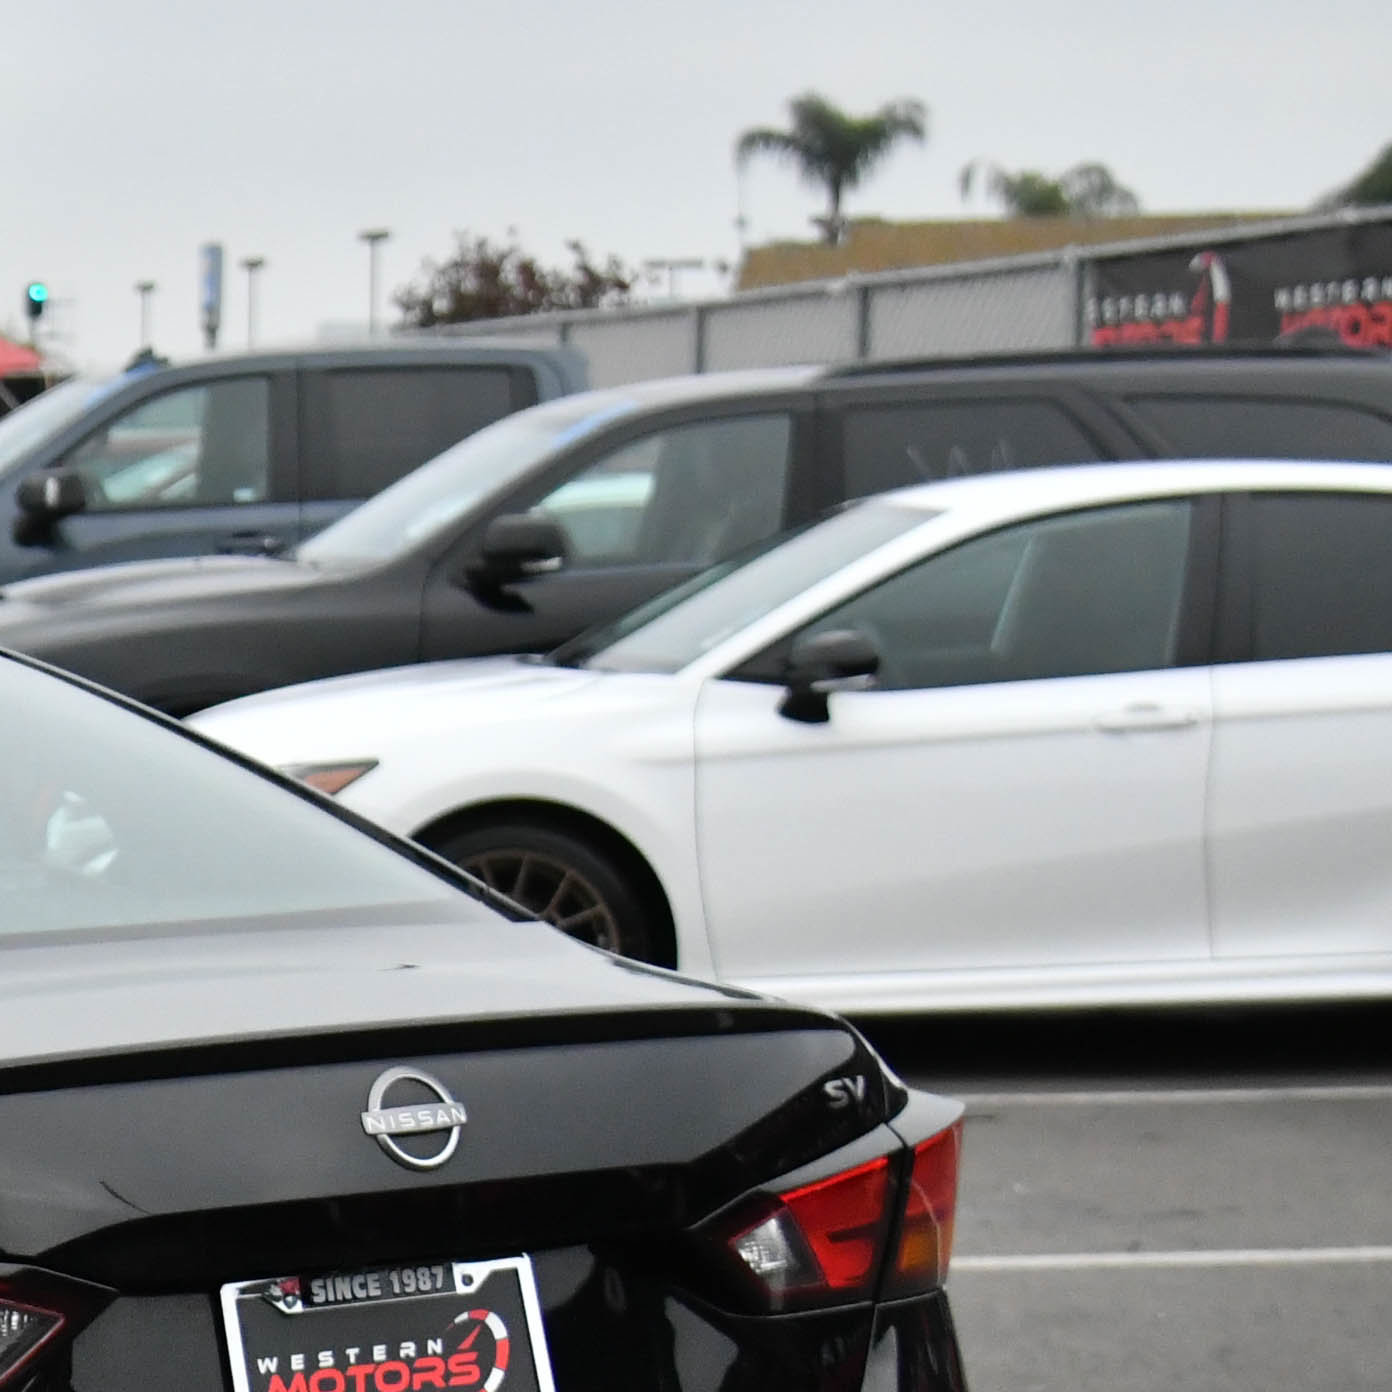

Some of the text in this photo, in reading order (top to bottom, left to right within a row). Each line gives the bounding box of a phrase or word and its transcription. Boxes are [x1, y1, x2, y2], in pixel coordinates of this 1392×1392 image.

[824, 1075, 865, 1108] SV
[366, 1106, 466, 1132] NISSAN
[310, 1265, 445, 1304] SINCE 1987
[257, 1338, 444, 1375] WESTERN
